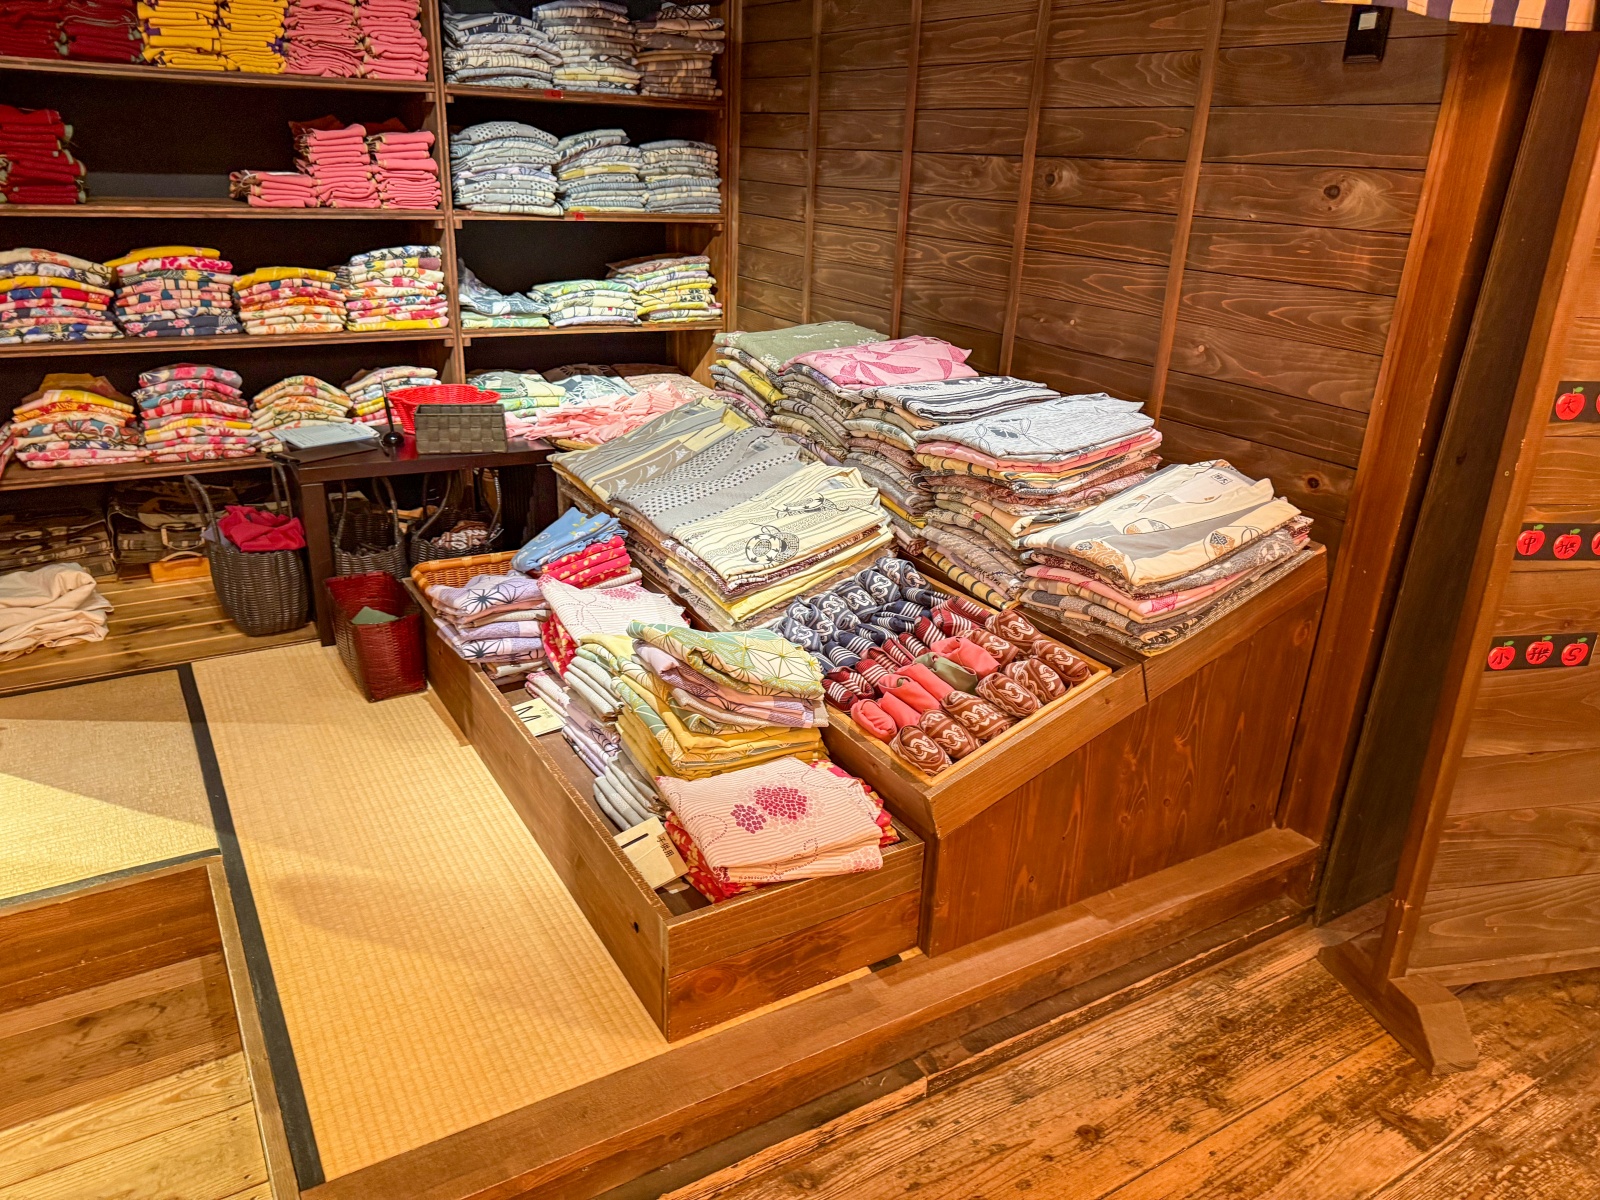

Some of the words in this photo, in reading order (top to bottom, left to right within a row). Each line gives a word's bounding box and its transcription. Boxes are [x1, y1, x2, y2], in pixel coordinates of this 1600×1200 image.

[1561, 398, 1577, 414] 大
[1523, 535, 1537, 554] 中
[1491, 653, 1510, 665] 小
[1565, 647, 1582, 662] S
[656, 836, 675, 858] 子供用
